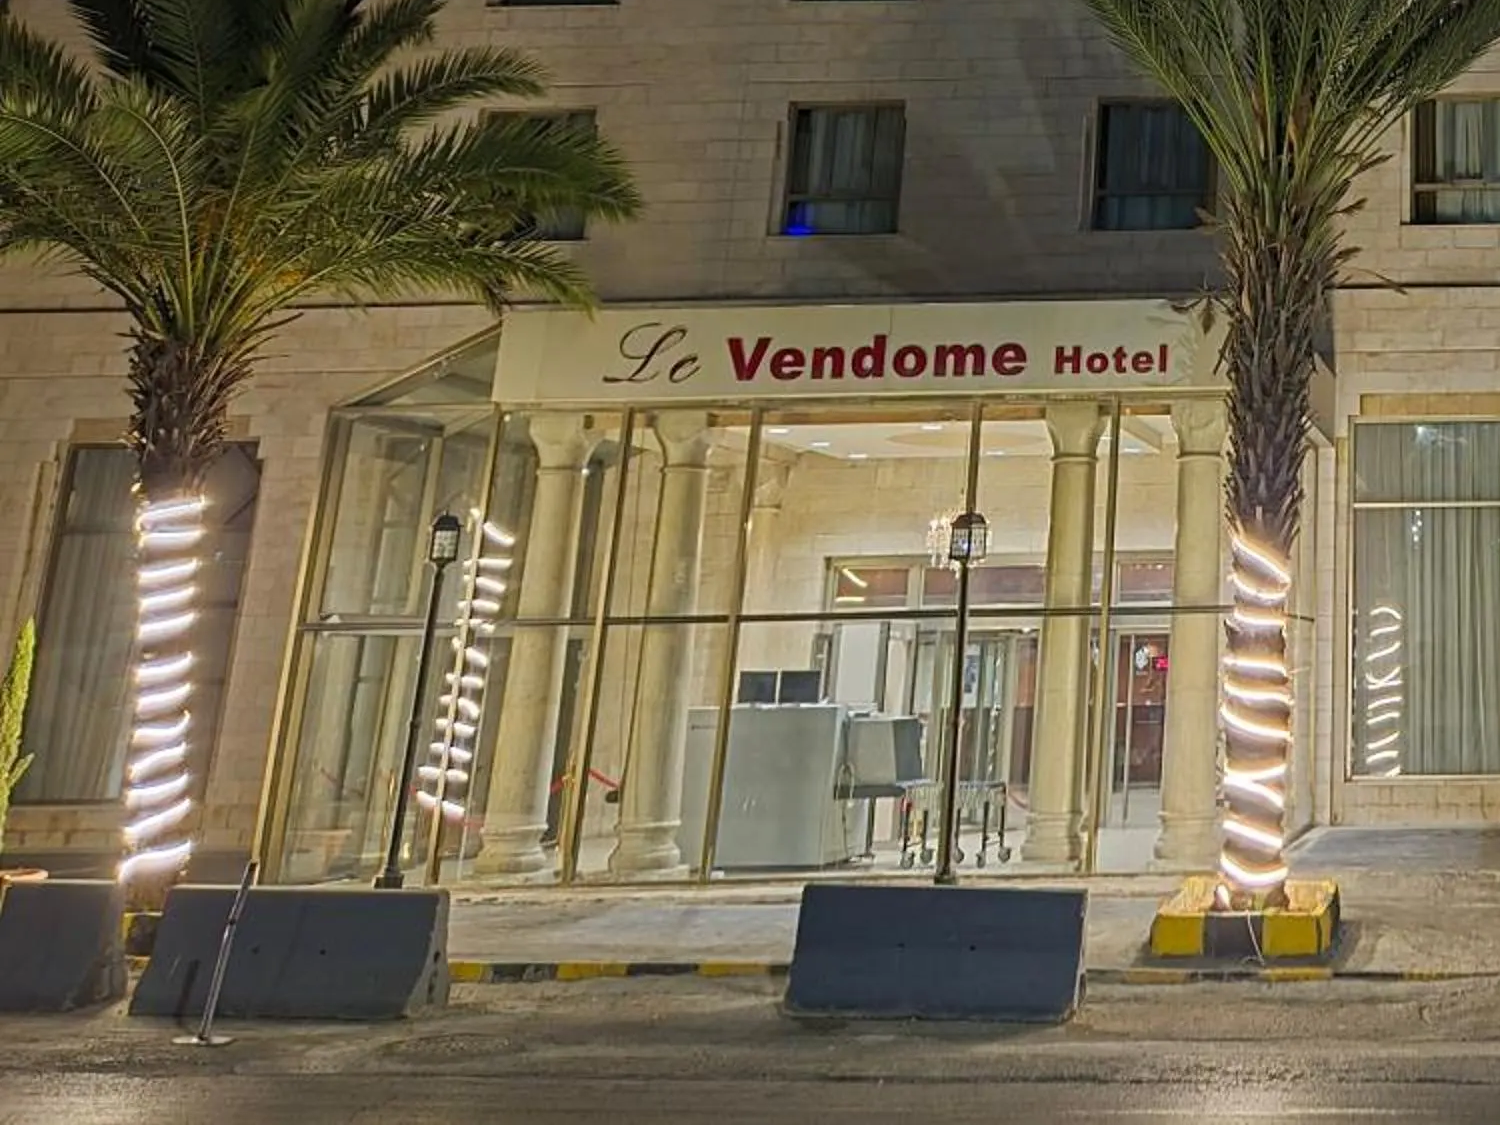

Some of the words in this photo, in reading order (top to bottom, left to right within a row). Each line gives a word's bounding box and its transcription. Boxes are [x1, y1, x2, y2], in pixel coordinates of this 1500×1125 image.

[602, 322, 701, 384] Le
[727, 334, 1027, 381] Vendome
[1054, 343, 1168, 374] Hotel
